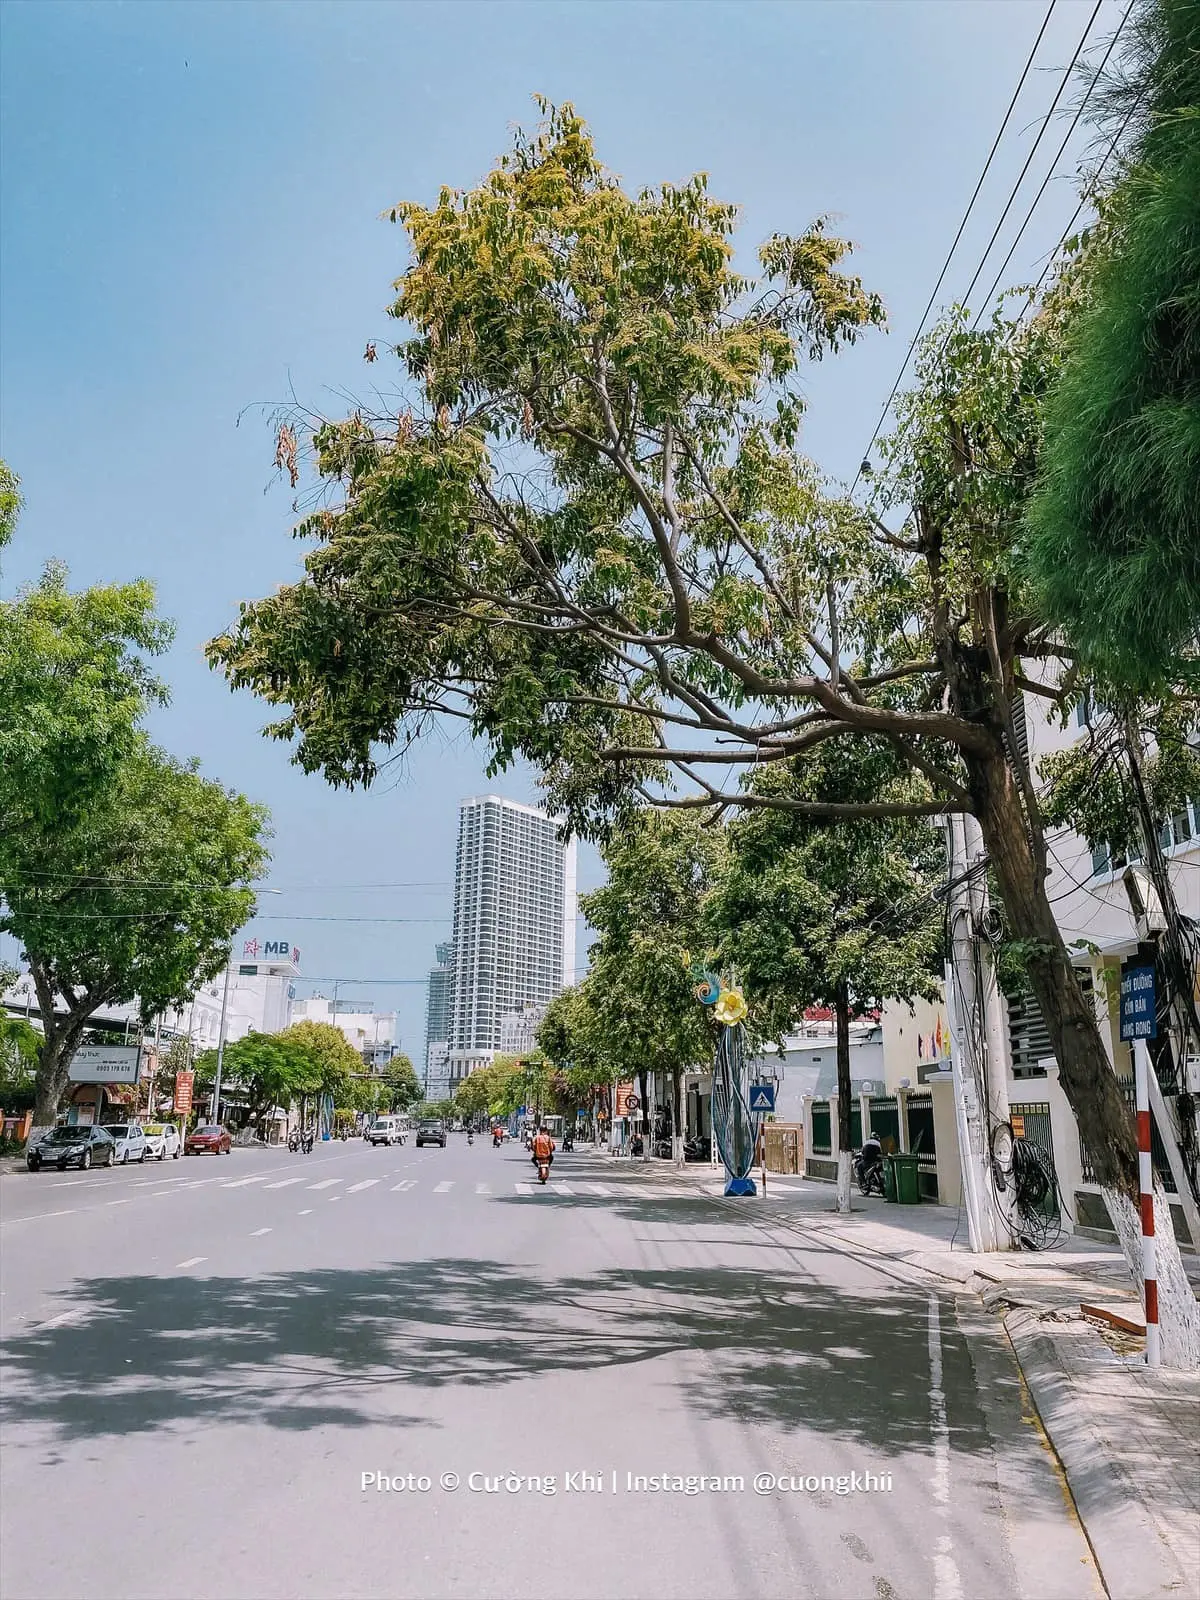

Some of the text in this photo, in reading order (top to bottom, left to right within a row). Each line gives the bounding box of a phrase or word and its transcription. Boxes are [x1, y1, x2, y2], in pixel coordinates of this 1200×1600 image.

[264, 941, 290, 954] MB
[1135, 995, 1147, 1013] BÁN
[1135, 1020, 1151, 1036] RONG
